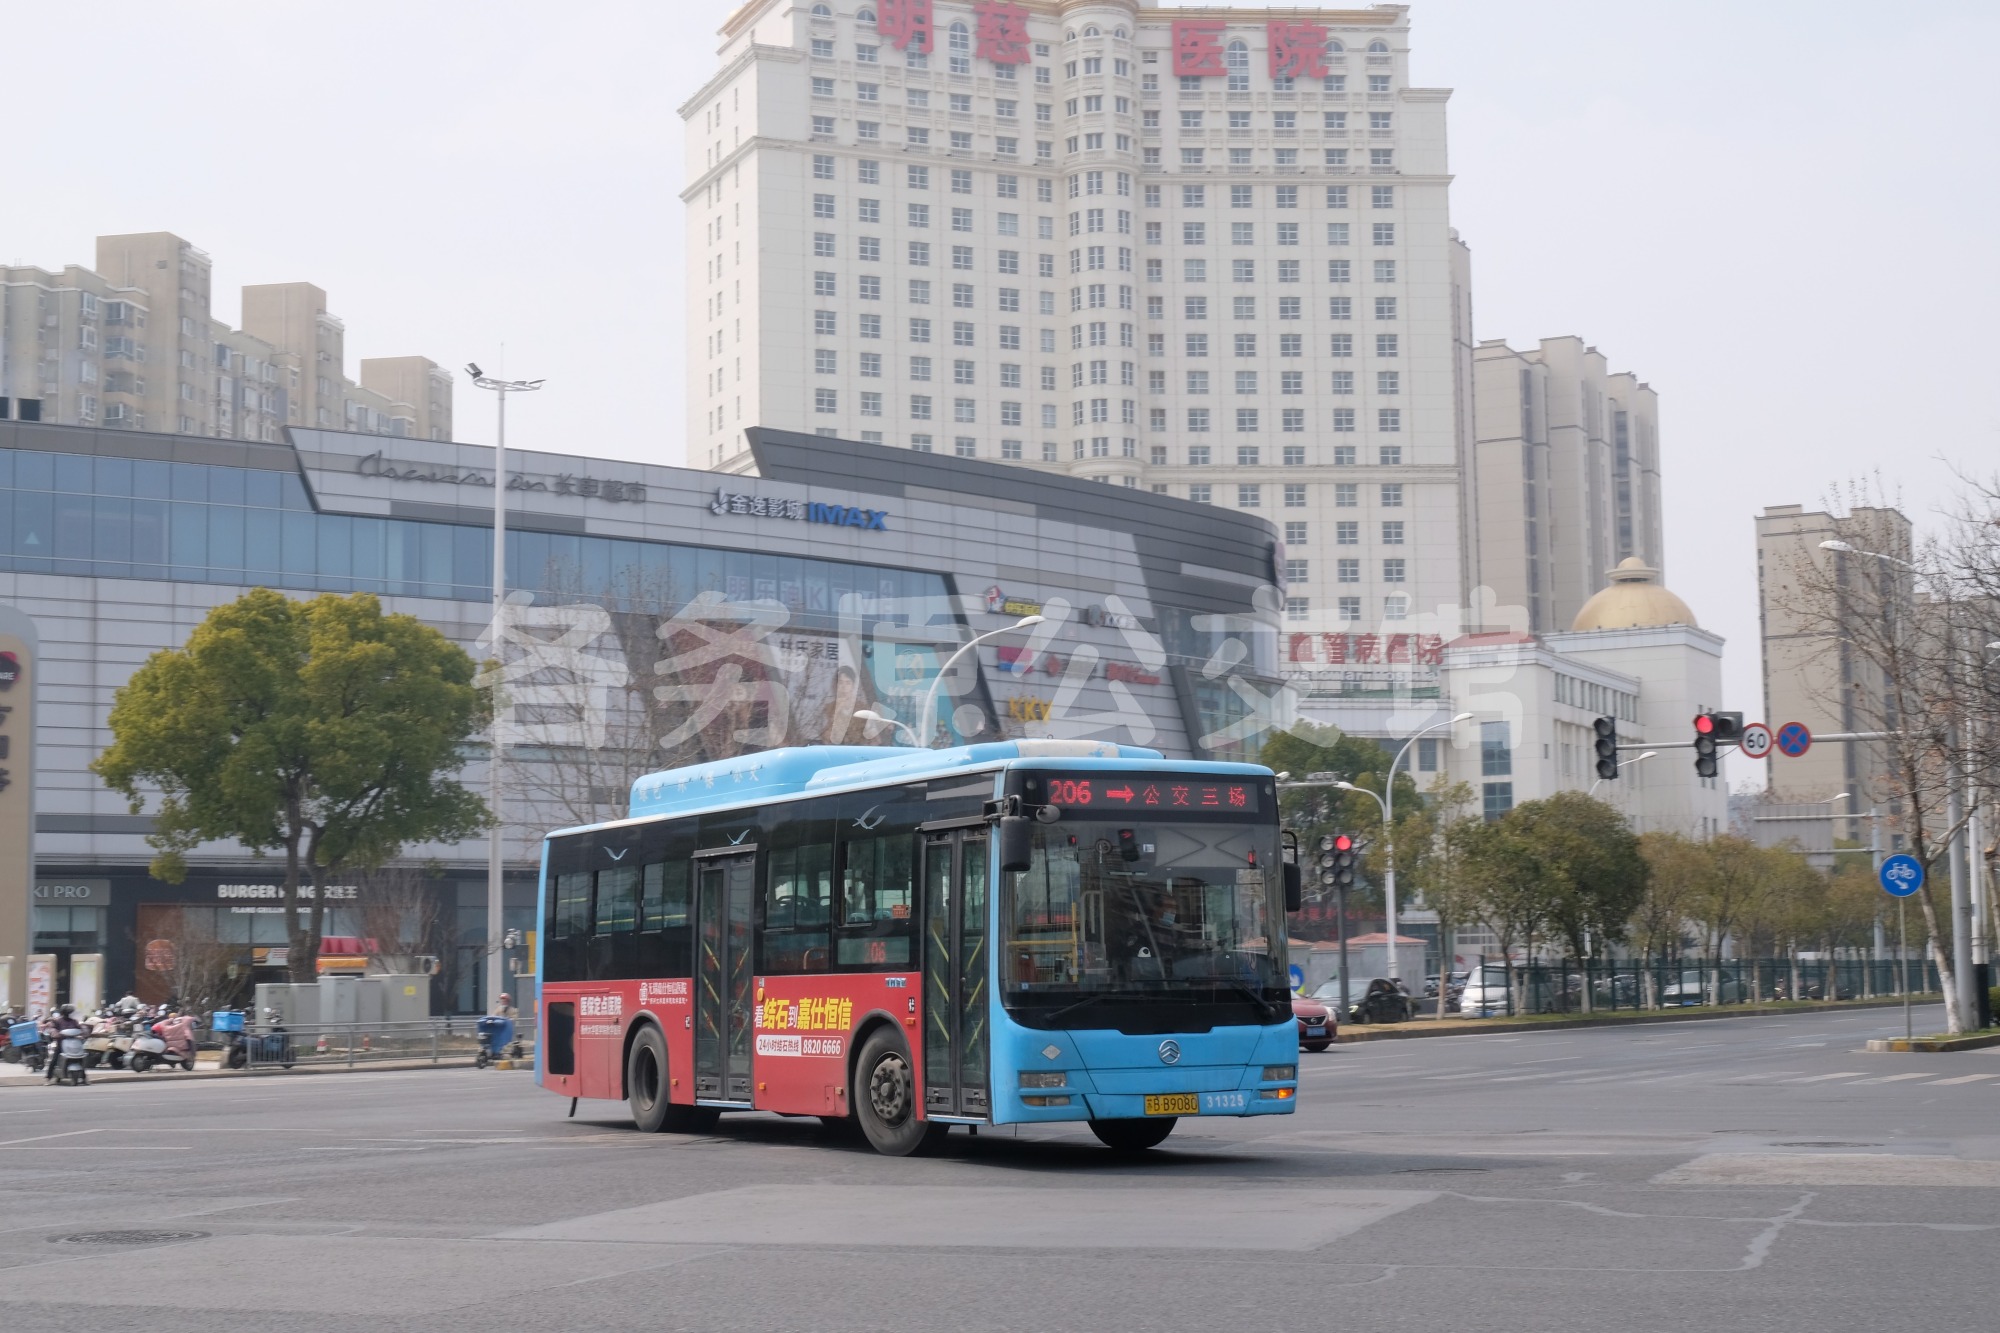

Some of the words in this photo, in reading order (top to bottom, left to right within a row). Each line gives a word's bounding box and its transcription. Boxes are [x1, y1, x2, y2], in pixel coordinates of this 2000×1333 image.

[731, 493, 804, 520] 金逸影城
[808, 501, 889, 531] IMAX
[1009, 696, 1054, 724] KKV
[1747, 733, 1766, 748] 60
[1050, 781, 1092, 804] 206
[53, 885, 91, 898] PRO
[218, 884, 277, 898] BURGER
[864, 942, 886, 964] 206
[580, 996, 622, 1015] 医保定点医院
[1207, 1095, 1245, 1108] 31325
